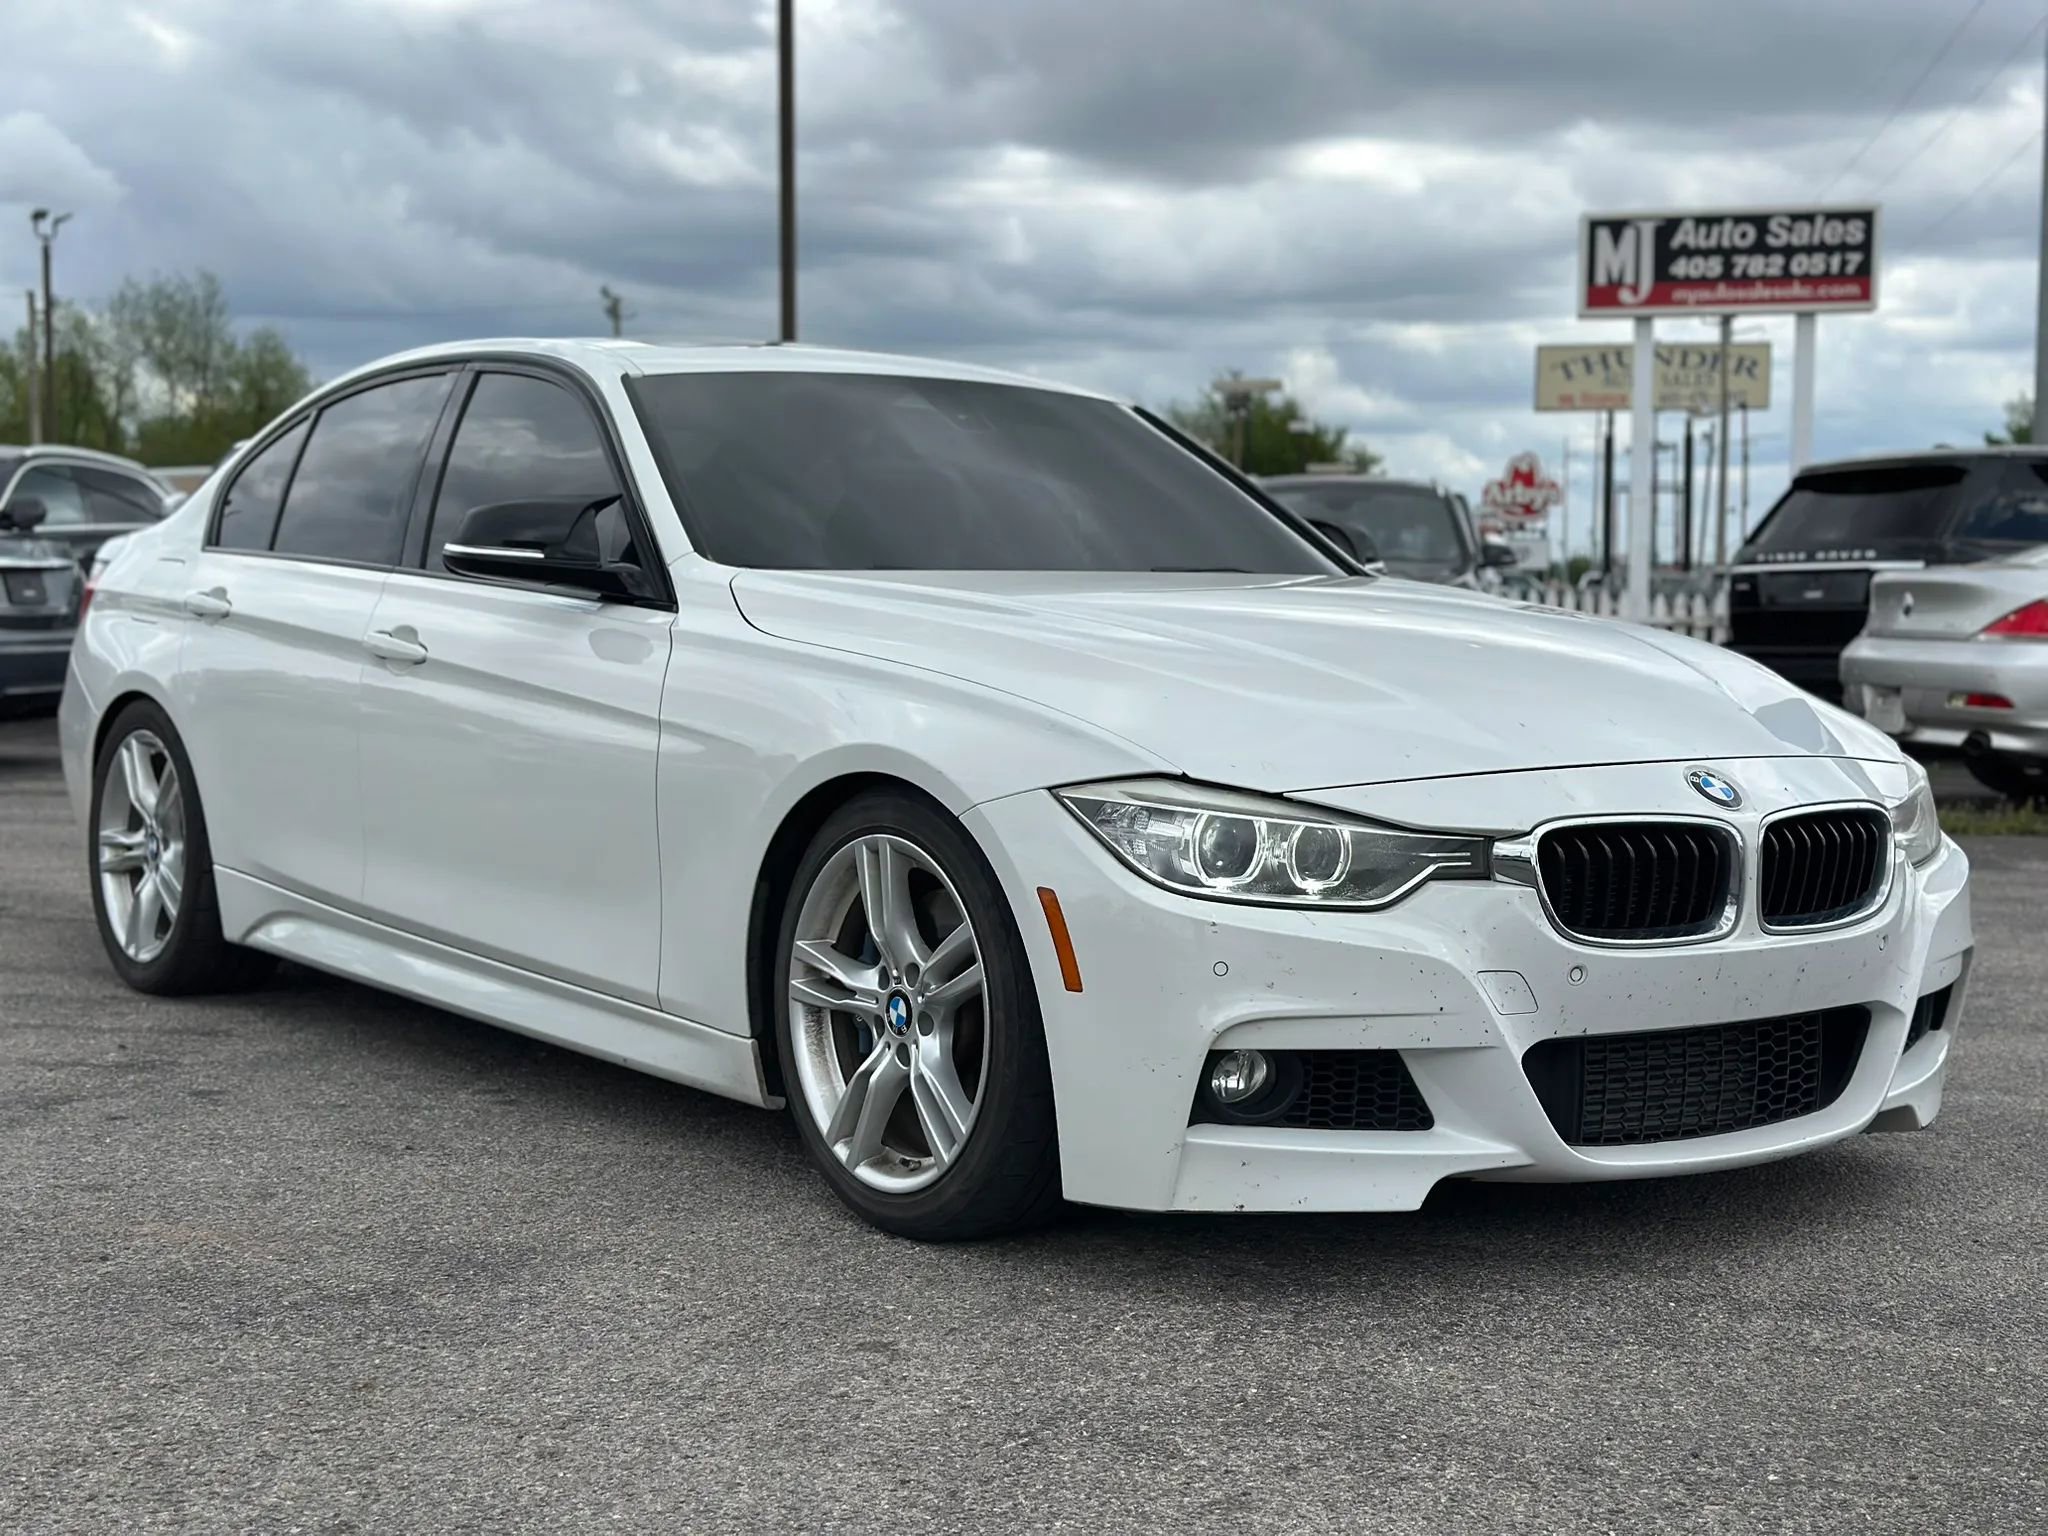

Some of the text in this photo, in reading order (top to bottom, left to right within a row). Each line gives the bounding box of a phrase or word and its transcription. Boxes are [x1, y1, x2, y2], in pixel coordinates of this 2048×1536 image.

[1670, 214, 1866, 250] Auto Sales
[1594, 220, 1666, 305] MJ
[1669, 252, 1864, 278] 405 782 0517
